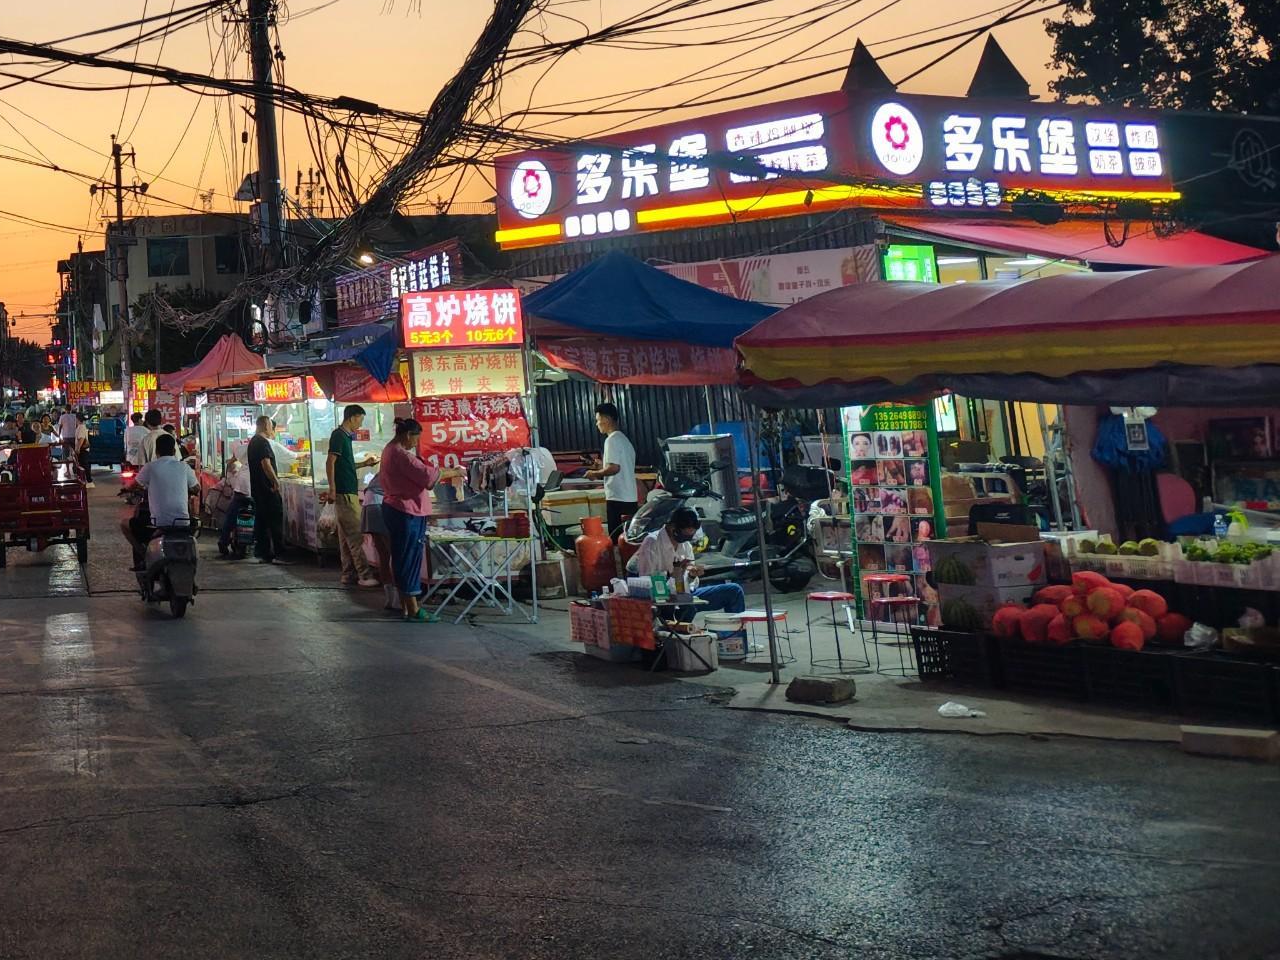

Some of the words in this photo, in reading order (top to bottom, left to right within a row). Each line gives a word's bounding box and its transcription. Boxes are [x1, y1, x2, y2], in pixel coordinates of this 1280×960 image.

[943, 114, 1078, 175] 多乐堡
[576, 133, 710, 205] 多乐堡
[406, 291, 517, 329] 高炉烧饼
[410, 330, 454, 345] 5元3个
[466, 328, 517, 342] 10元6个
[418, 352, 518, 373] 豫东高炉烧饼
[420, 375, 521, 395] 烧饼夹菜
[422, 396, 521, 417] 正宗豫东烧饼
[874, 411, 888, 421] 135
[431, 417, 519, 444] 5元3个
[875, 421, 890, 430] 132
